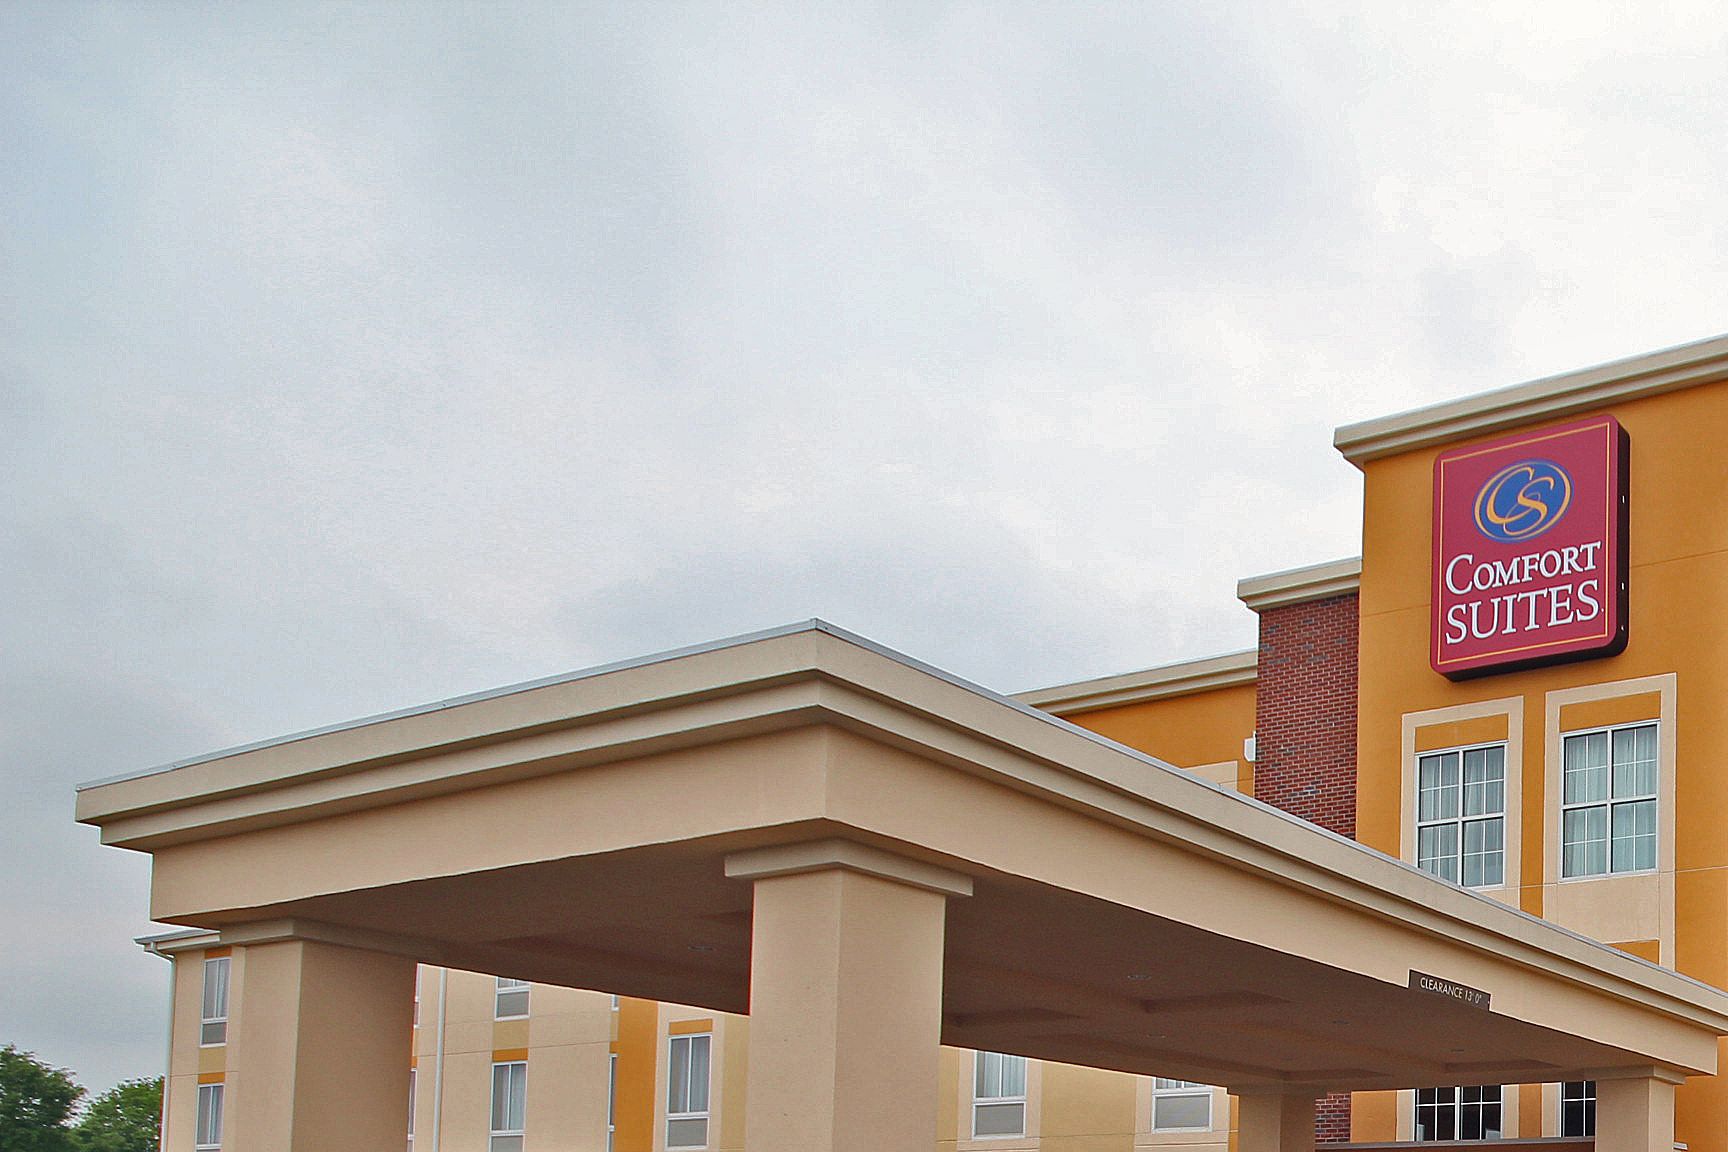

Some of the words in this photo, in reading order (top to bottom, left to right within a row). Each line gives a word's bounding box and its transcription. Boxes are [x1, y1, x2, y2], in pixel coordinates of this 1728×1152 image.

[1445, 541, 1602, 595] COMFORT
[1445, 579, 1600, 645] SUITES
[1420, 977, 1463, 999] CLEARANCE
